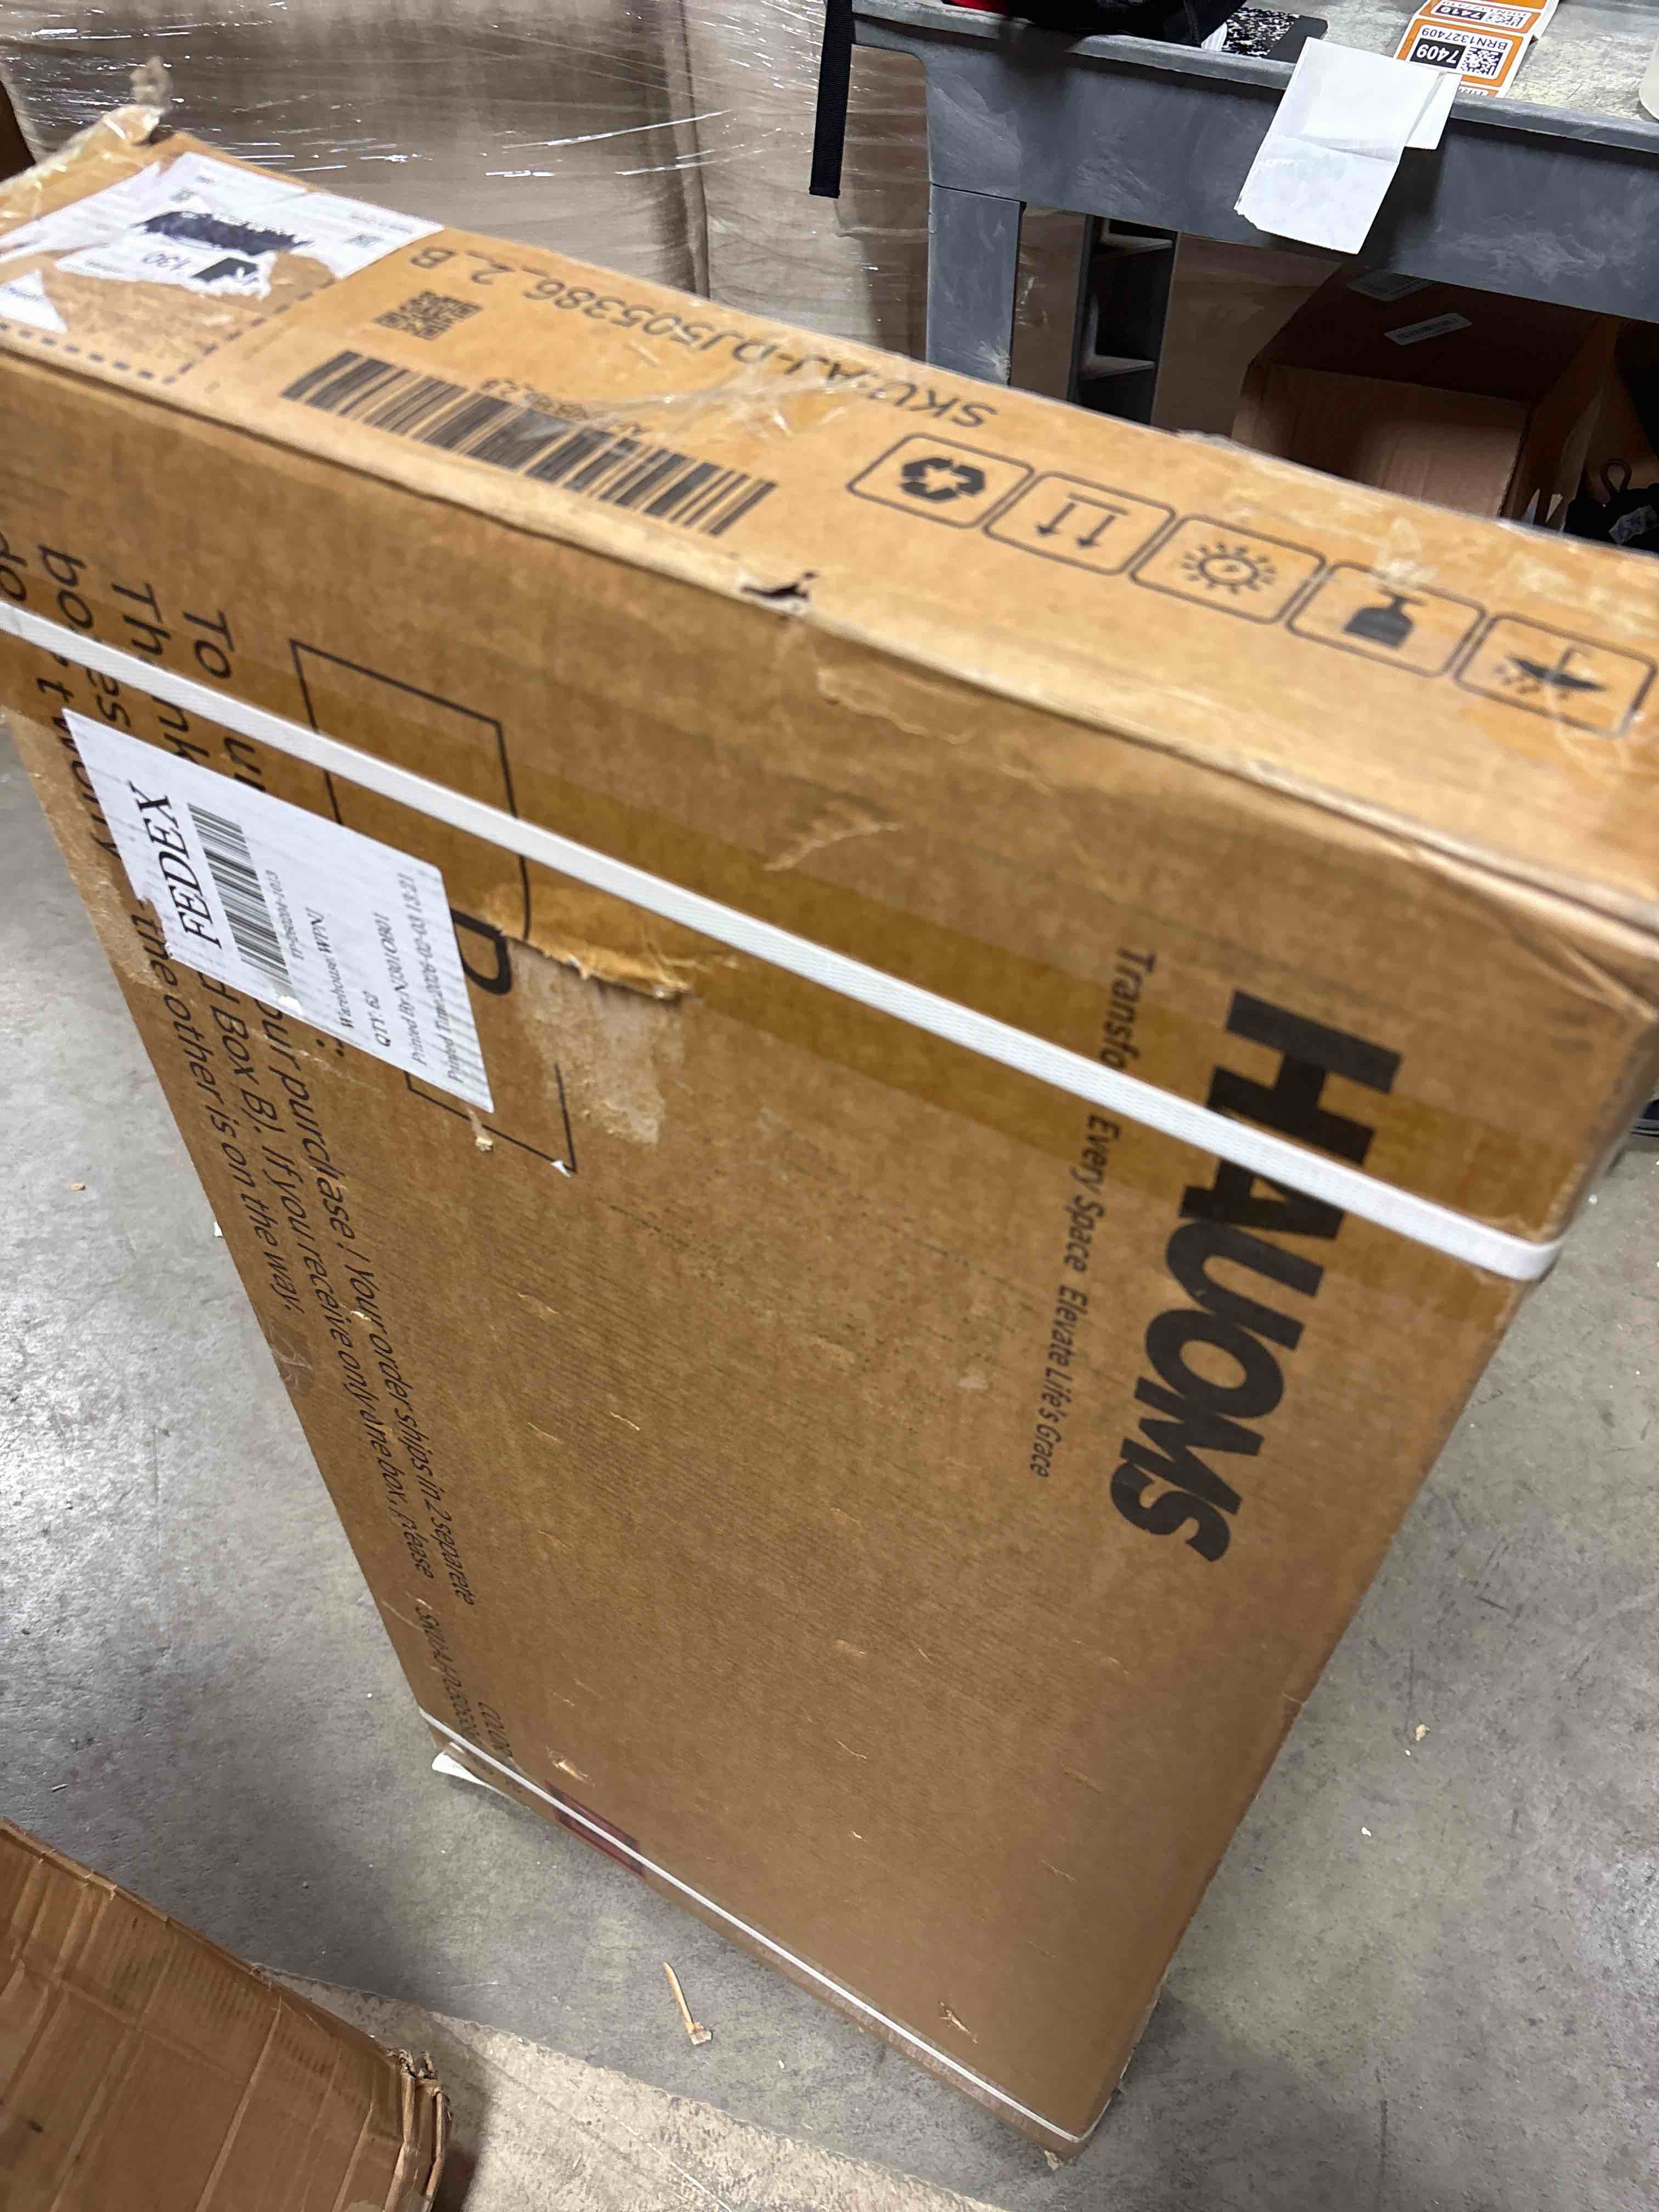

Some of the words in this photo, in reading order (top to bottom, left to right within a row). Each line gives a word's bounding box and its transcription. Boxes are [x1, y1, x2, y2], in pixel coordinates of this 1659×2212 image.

[1422, 27, 1508, 50] BRN1327409
[1440, 6, 1482, 19] 7410
[1416, 44, 1459, 64] 7409
[38, 545, 131, 727] boes
[183, 610, 235, 679] To
[111, 583, 210, 764] Thnk
[129, 780, 222, 949] FEDEX
[403, 1015, 428, 1065] Printed
[1100, 949, 1156, 1070] Transfo
[163, 995, 224, 1105] other
[210, 1006, 259, 1085] Box
[439, 1032, 464, 1084] Printed
[206, 1105, 240, 1138] is
[268, 1066, 357, 1240] purchase
[1071, 1114, 1121, 1195] Every
[221, 1142, 256, 1188] on
[261, 1146, 303, 1184] If
[241, 1194, 279, 1246] the
[262, 1169, 315, 1240] you
[1065, 1195, 1105, 1273] Space
[263, 1252, 305, 1314] way.
[298, 1243, 353, 1347] receive
[345, 1265, 387, 1334] Your
[1110, 989, 1403, 1562] HAUOMS
[1048, 1285, 1089, 1367] Elevate
[338, 1350, 380, 1410] only
[369, 1333, 412, 1412] order
[1039, 1367, 1075, 1423] Life's
[359, 1409, 392, 1457] one
[394, 1408, 433, 1476] ships
[1030, 1423, 1063, 1479] Grace
[376, 1457, 409, 1505] box,
[416, 1475, 445, 1501] in
[425, 1499, 453, 1521] 2
[388, 1508, 435, 1579] please
